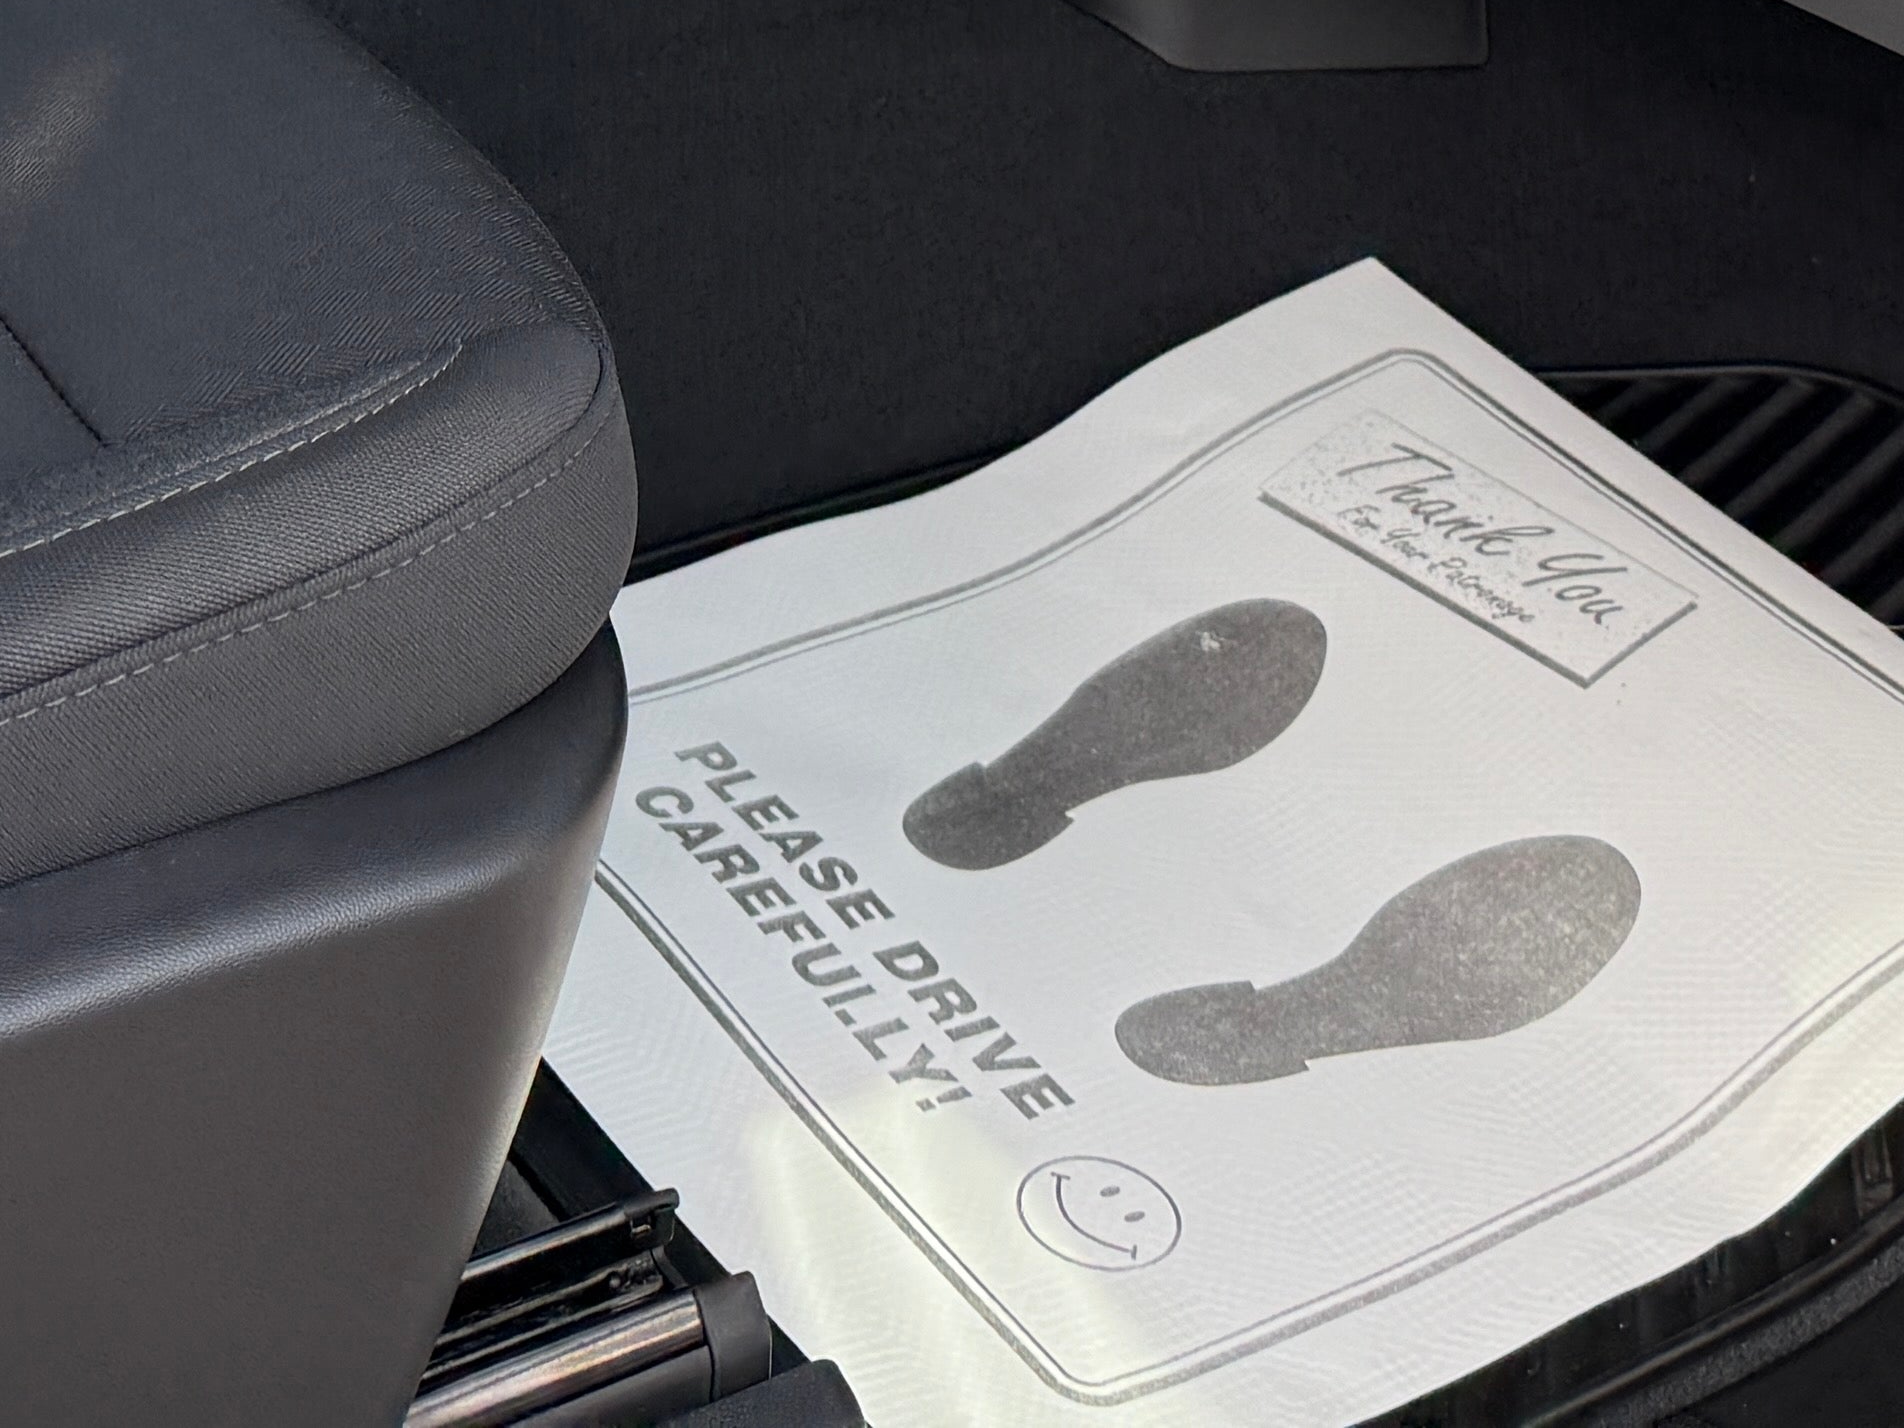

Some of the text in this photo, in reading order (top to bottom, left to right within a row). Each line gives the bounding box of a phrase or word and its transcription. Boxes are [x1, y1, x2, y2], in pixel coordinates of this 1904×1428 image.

[1337, 442, 1628, 625] Thank You
[1337, 505, 1537, 624] For Your Patronage
[635, 785, 973, 1113] CAREFULLY!
[674, 740, 1076, 1120] PLEASE DRIVE
